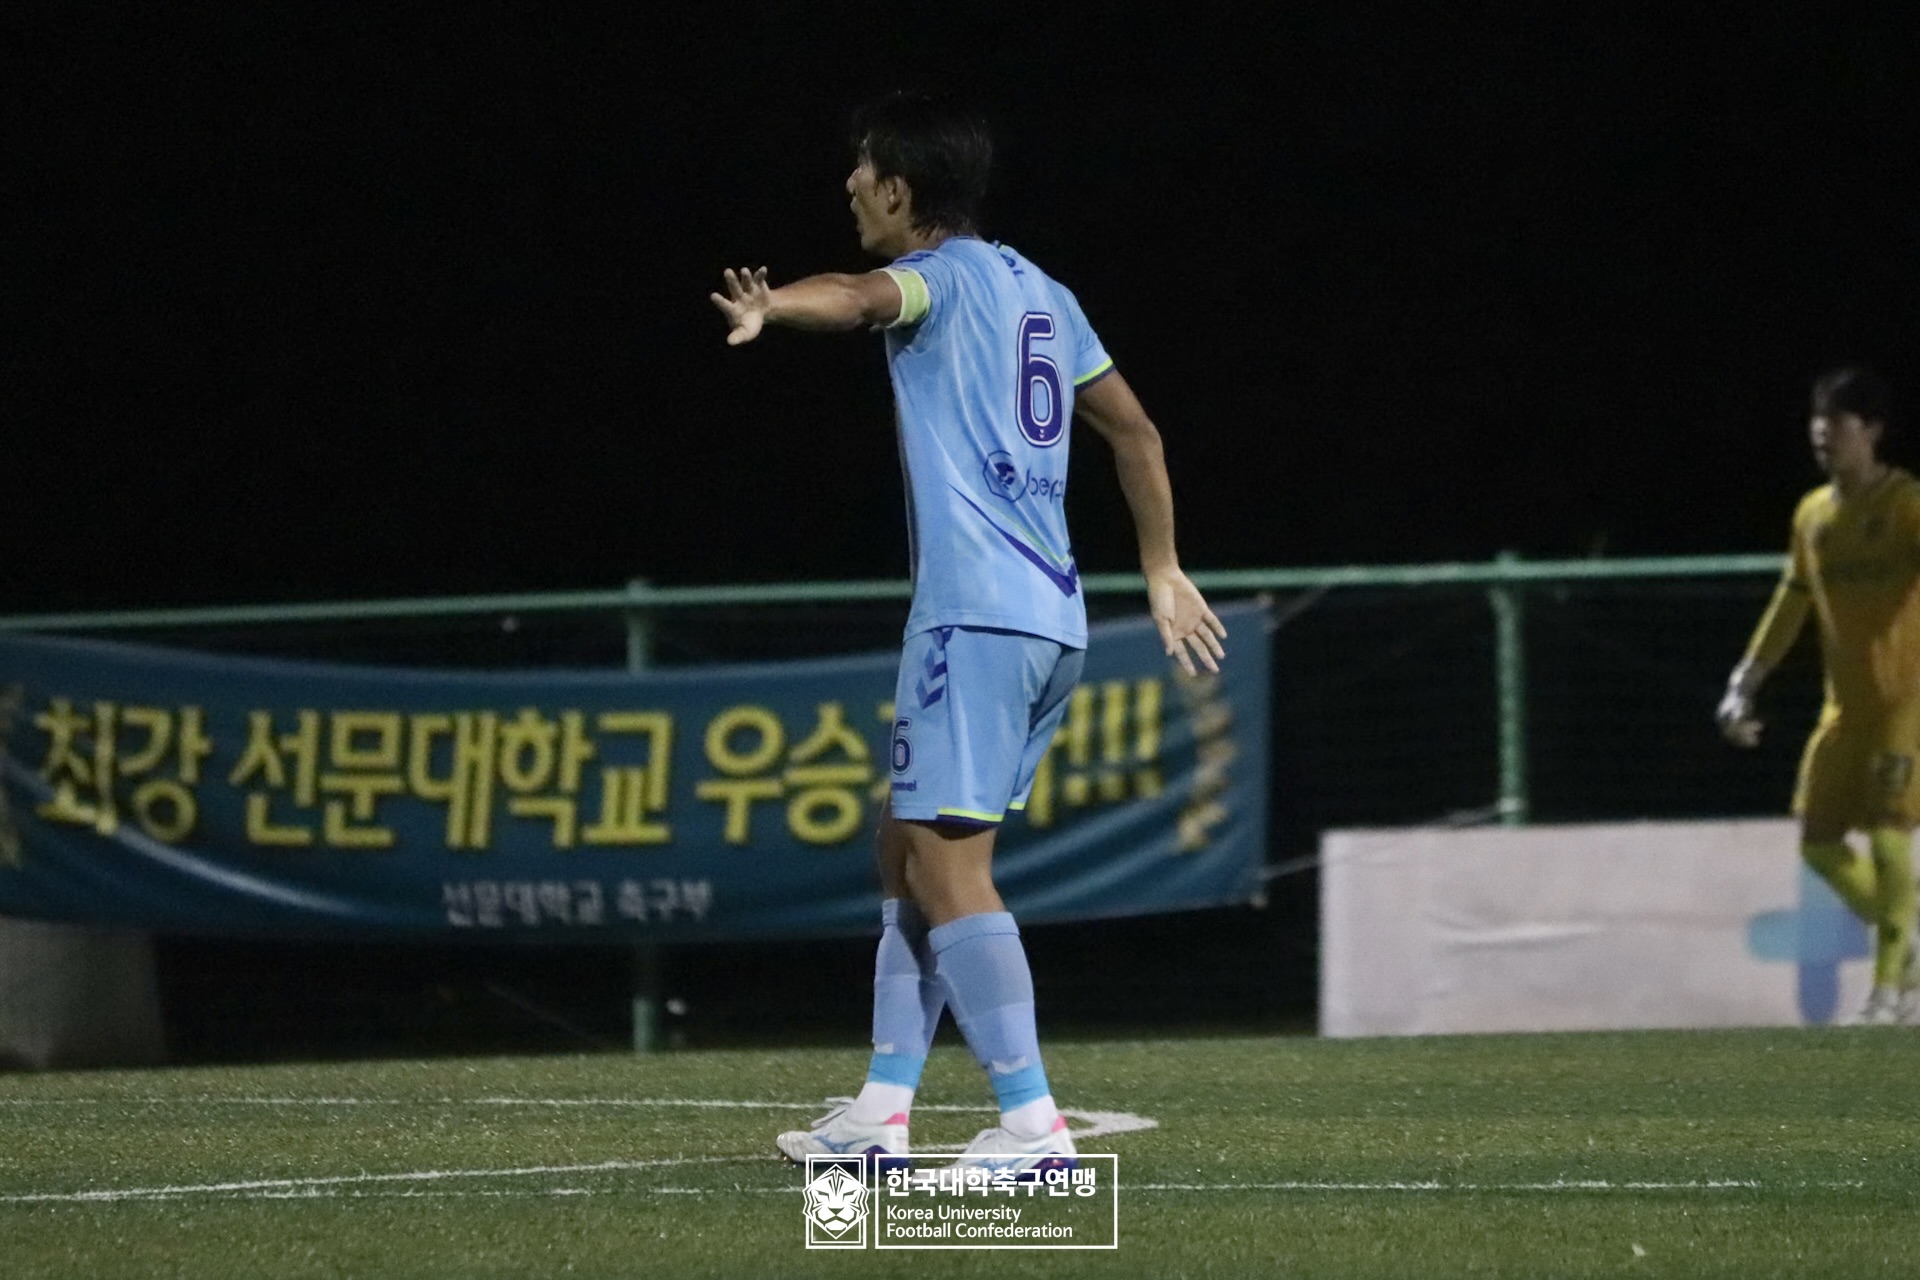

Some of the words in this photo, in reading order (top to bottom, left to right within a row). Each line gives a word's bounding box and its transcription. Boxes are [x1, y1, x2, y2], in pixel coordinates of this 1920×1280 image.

[1016, 311, 1064, 448] 6
[33, 698, 210, 842] 최강
[230, 706, 672, 850] 선문대학교
[891, 717, 914, 776] 6
